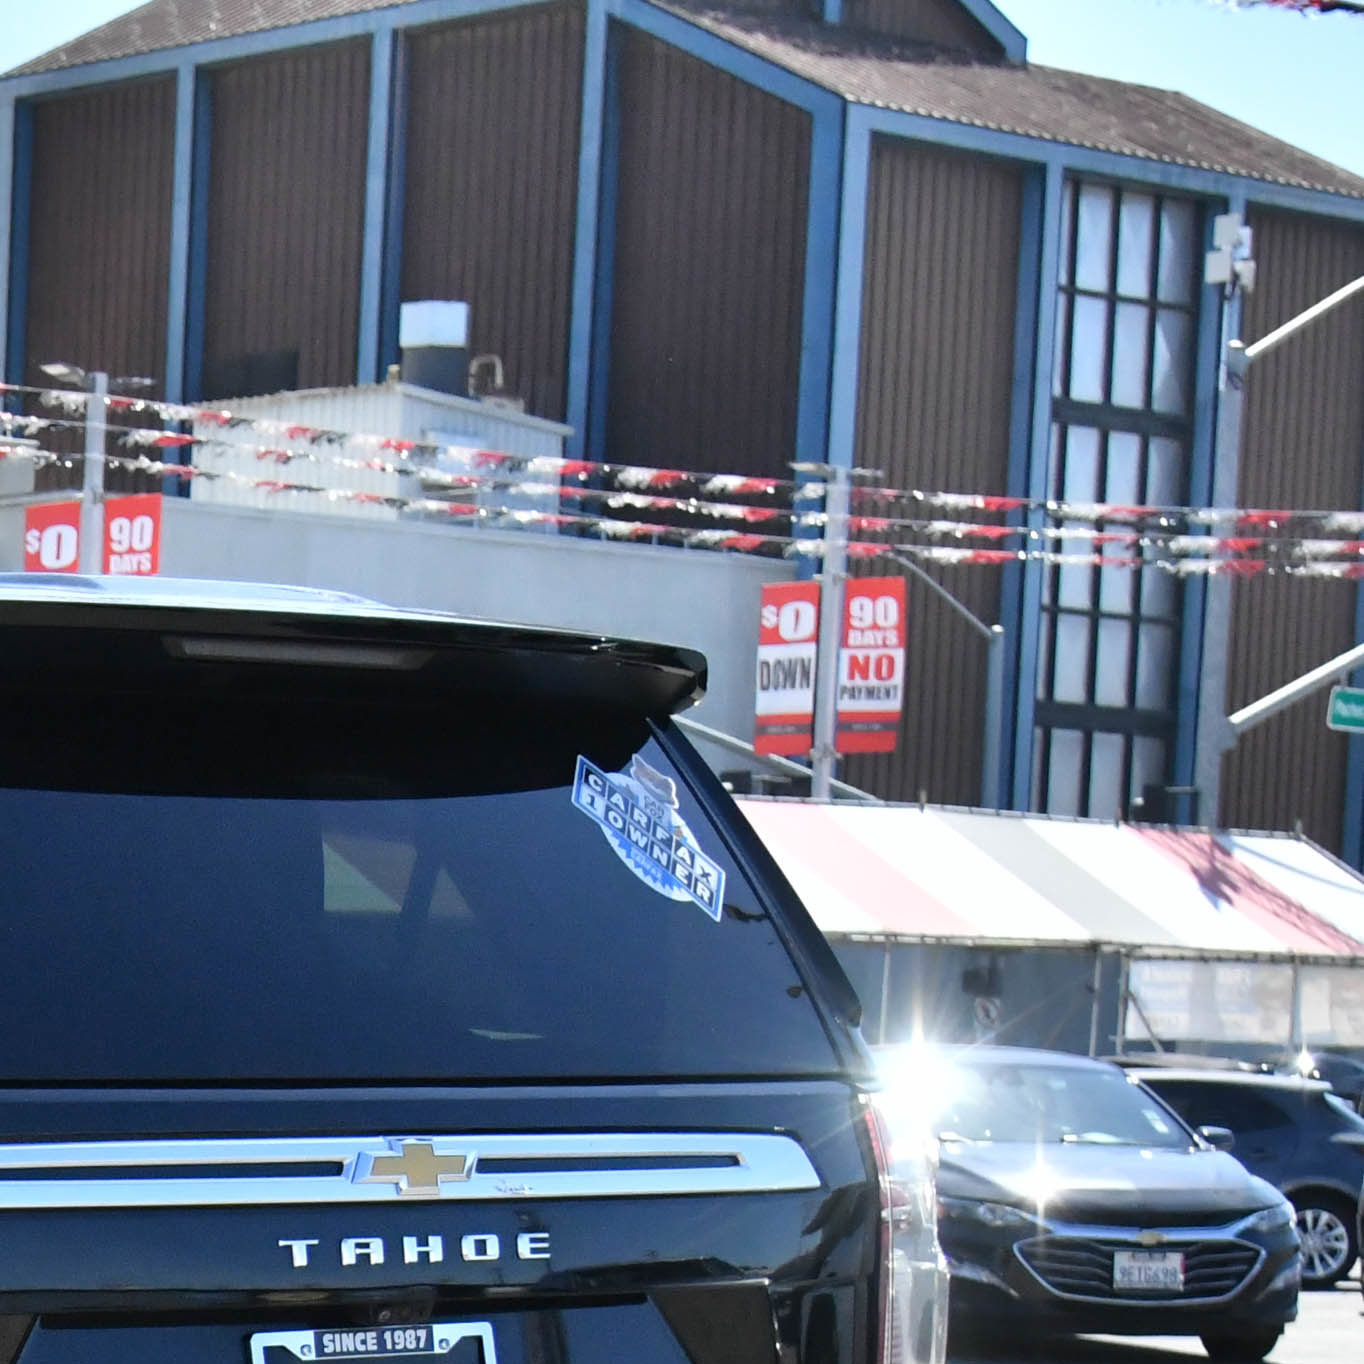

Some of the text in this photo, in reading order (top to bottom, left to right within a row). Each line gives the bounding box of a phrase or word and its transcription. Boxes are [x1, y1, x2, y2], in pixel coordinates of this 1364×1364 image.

[25, 523, 79, 570] $0
[110, 515, 155, 553] 90
[760, 600, 817, 642] $0
[849, 595, 900, 630] 90
[847, 628, 899, 648] DAYS
[759, 657, 812, 692] DOWN
[848, 653, 895, 681] NO
[839, 684, 899, 701] PAYMENT
[587, 773, 713, 886] CARFAX
[278, 1232, 552, 1268] TAHOE
[322, 1328, 427, 1353] SINCE 1987
